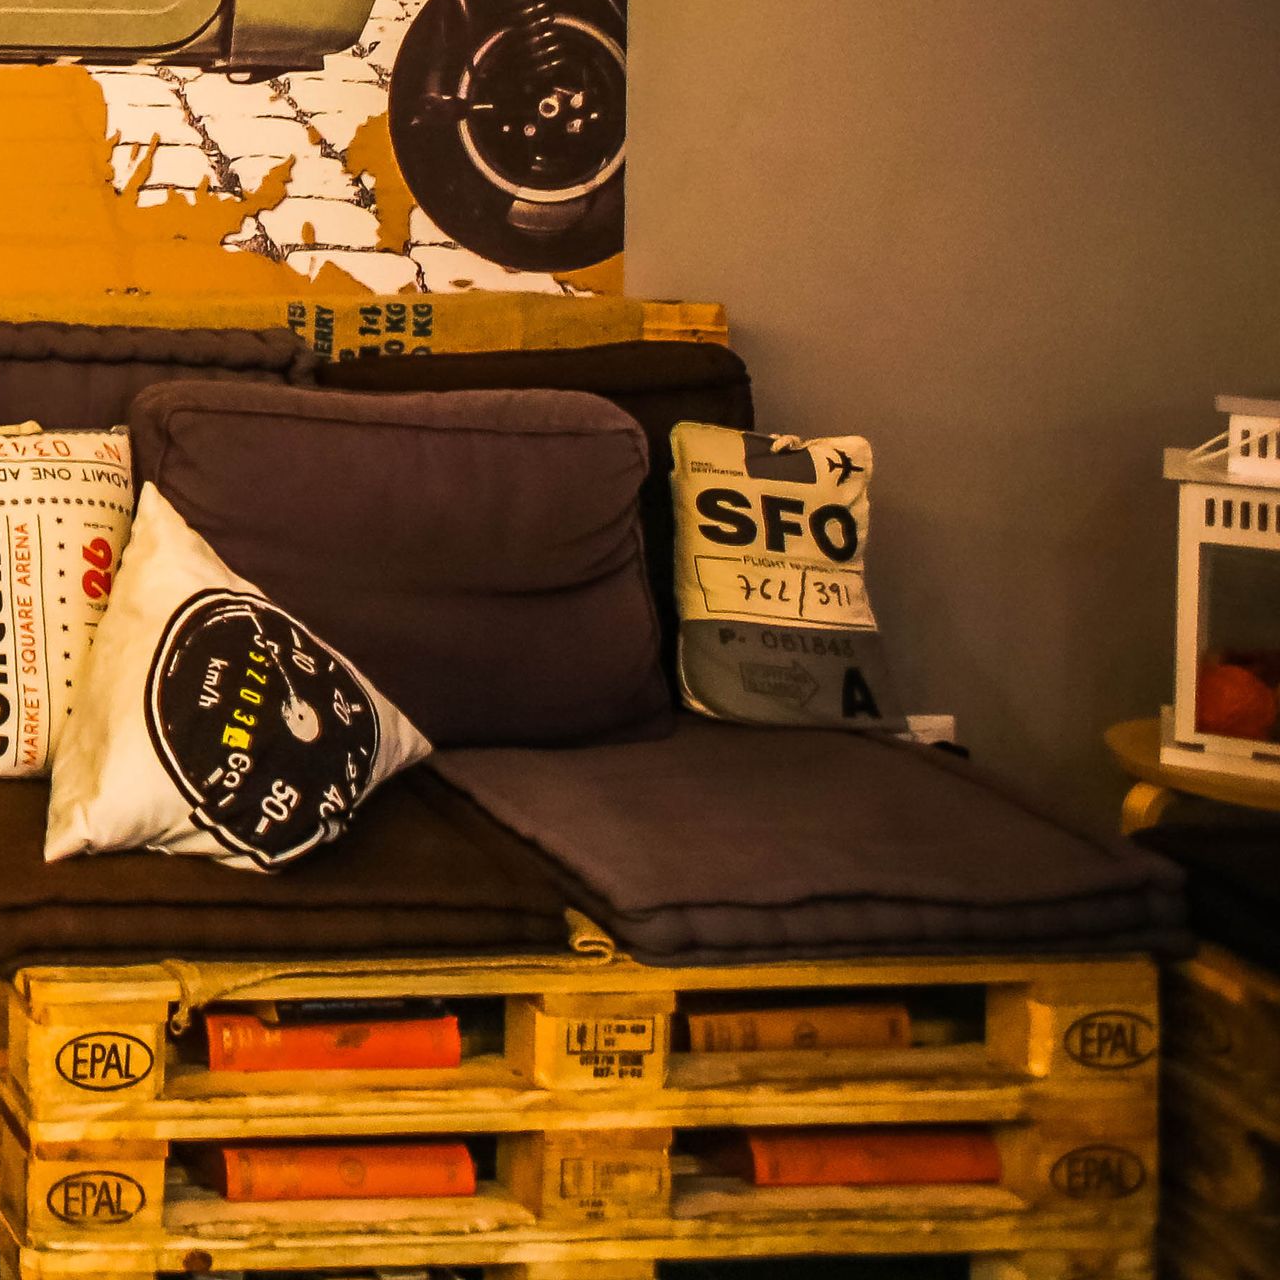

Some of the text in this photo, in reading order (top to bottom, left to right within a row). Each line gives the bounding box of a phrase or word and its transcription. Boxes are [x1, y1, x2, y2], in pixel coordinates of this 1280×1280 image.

[385, 303, 407, 333] KG
[412, 303, 433, 337] KG
[31, 466, 72, 481] ONE
[81, 469, 129, 490] ADMIT
[695, 488, 858, 563] SFO
[14, 523, 40, 769] MARKET SQUARE ARENA
[196, 656, 230, 709] km/h
[842, 666, 882, 720] A
[261, 780, 302, 822] 50
[1077, 1025, 1143, 1059] EPAL
[71, 1043, 138, 1080] EPAL
[1065, 1160, 1130, 1193] EPAL
[64, 1185, 128, 1218] EPAL
